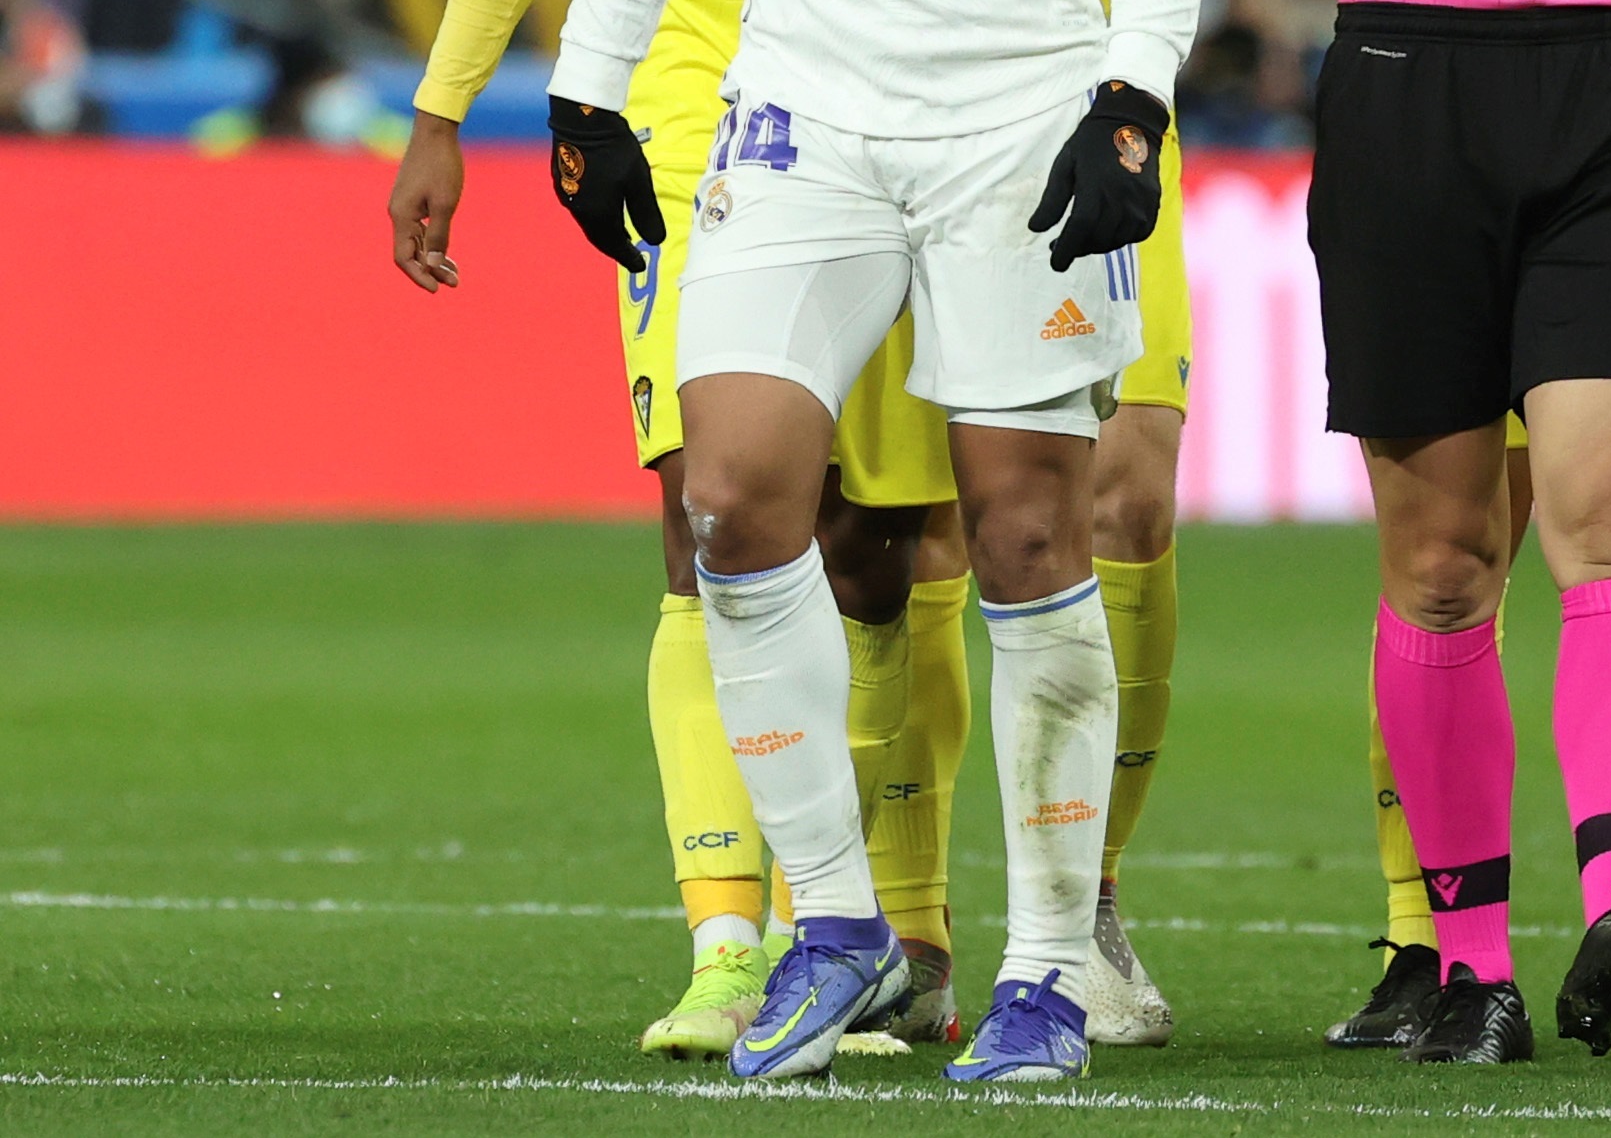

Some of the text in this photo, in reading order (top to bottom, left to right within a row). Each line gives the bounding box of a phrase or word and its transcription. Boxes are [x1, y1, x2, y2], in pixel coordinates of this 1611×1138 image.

[627, 239, 662, 341] 9
[1039, 322, 1097, 341] adidas
[730, 730, 805, 757] MADRID
[736, 730, 787, 747] REAL
[1116, 749, 1157, 768] CF
[882, 782, 920, 801] CF
[1038, 798, 1090, 815] REAL
[1025, 807, 1098, 827] MADRID
[683, 831, 740, 851] CCF
